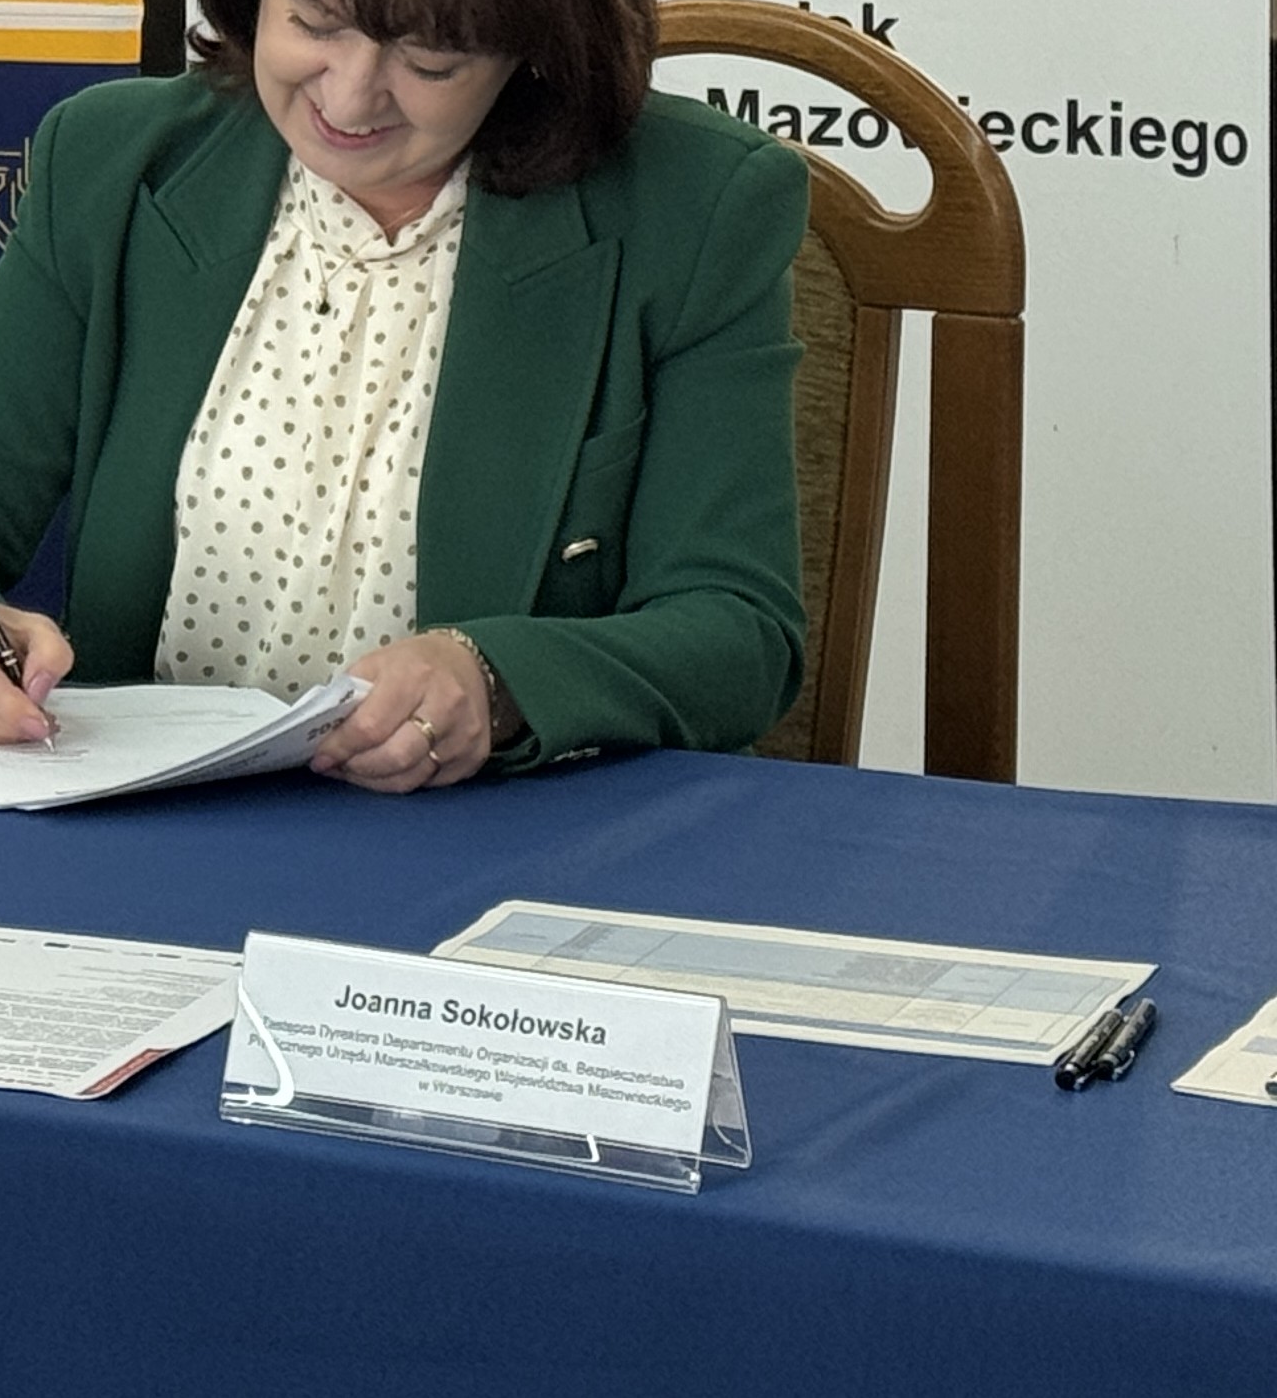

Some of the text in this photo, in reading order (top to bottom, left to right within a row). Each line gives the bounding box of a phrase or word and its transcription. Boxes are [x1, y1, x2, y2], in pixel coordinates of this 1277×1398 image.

[334, 984, 608, 1046] Joanna Sokołowska
[374, 1051, 491, 1083] Marszałkowskiego
[588, 1082, 692, 1113] Mazowieckiego
[382, 1033, 473, 1058] Departamentu
[476, 1046, 549, 1073] Organizacji
